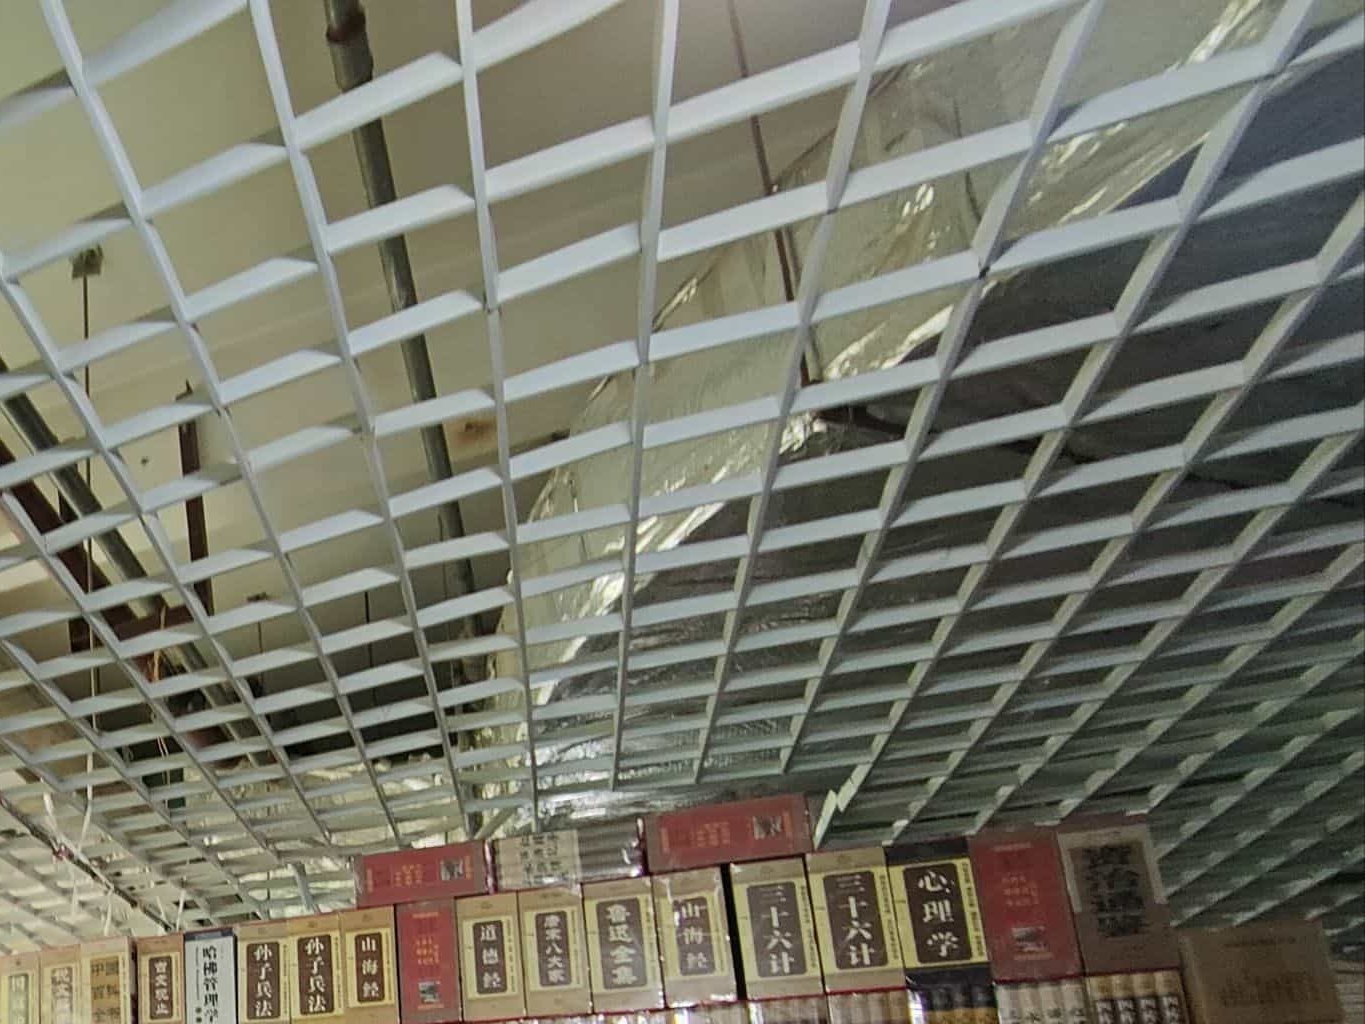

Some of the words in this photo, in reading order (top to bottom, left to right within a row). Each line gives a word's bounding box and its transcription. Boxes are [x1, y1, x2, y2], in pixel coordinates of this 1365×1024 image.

[606, 902, 638, 986] 鲁迅全集
[678, 900, 711, 972] 山海经
[760, 884, 795, 974] 三十六计
[835, 874, 875, 966] 三十六计
[917, 870, 960, 958] 心理学
[202, 944, 219, 1024] 哈佛管理学
[252, 944, 274, 1018] 孙子兵法
[304, 936, 327, 1014] 孙子兵法
[361, 936, 380, 999] 山海经
